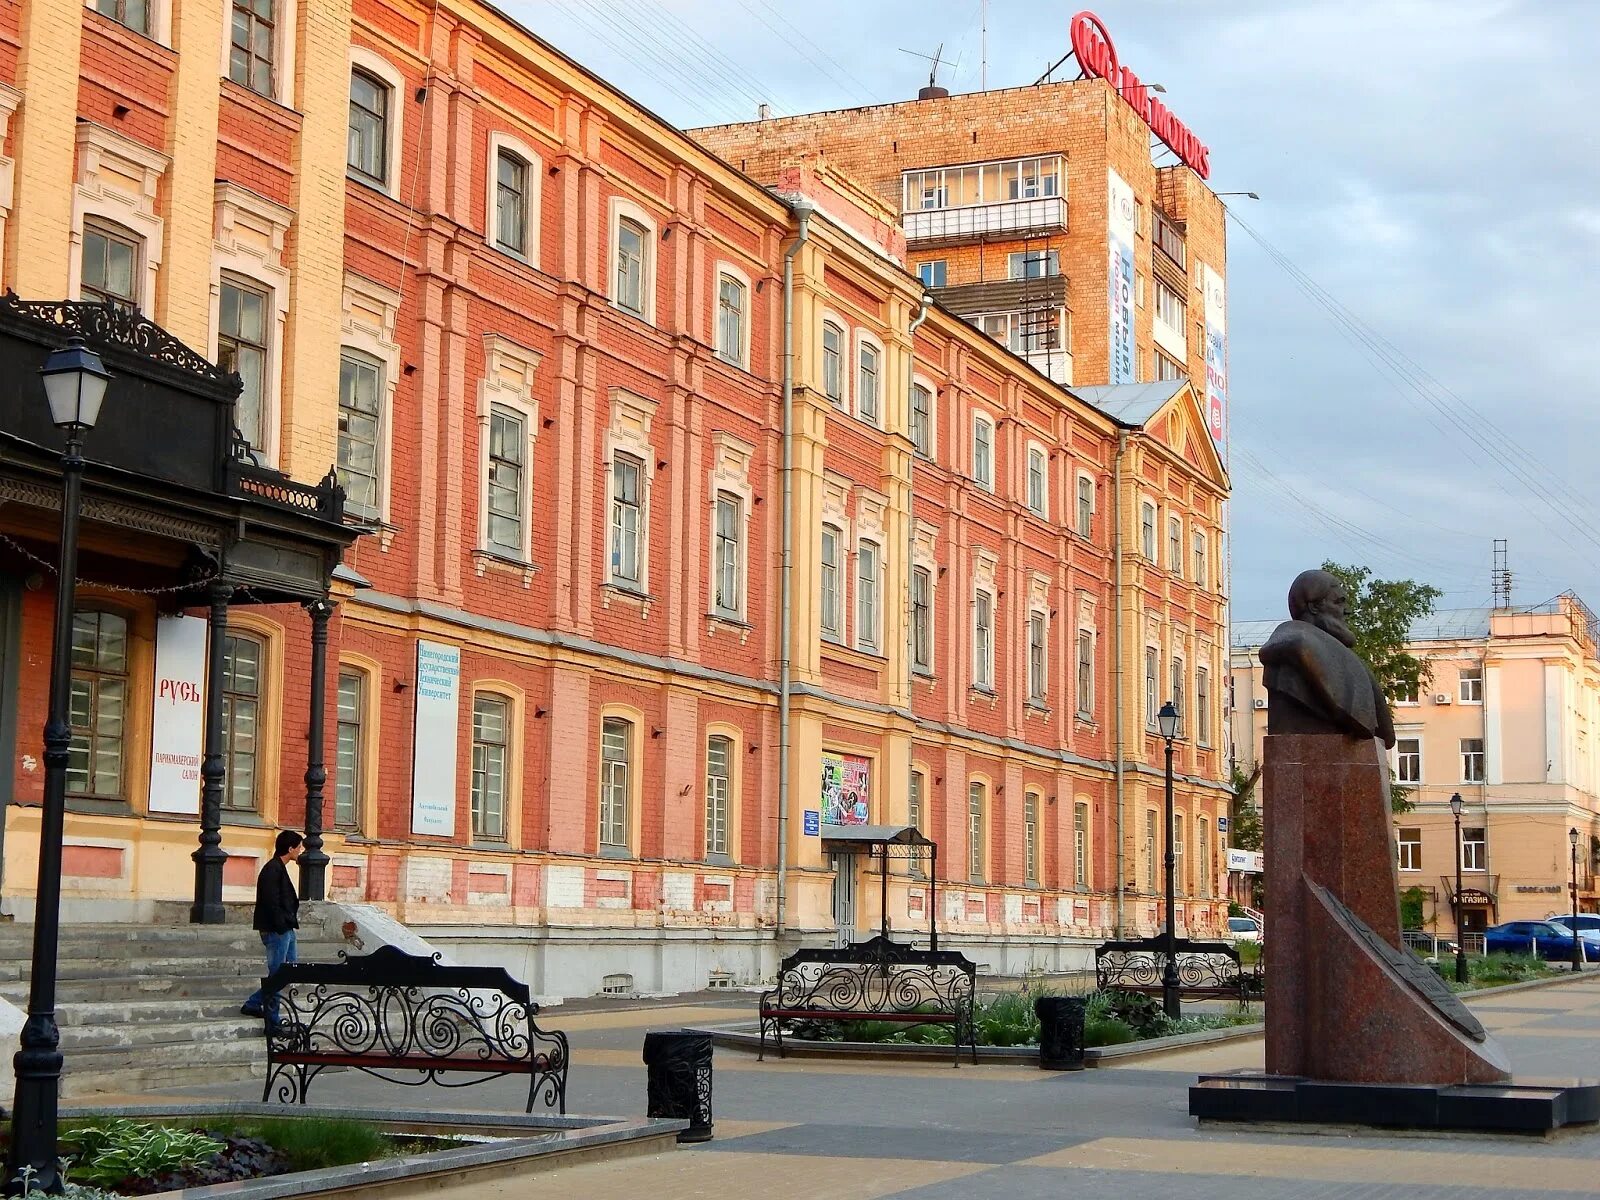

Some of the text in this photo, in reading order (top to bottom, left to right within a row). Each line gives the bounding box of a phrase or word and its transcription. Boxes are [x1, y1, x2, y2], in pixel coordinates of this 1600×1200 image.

[1150, 97, 1211, 180] MOTORS
[1121, 256, 1131, 375] Новый
[1207, 364, 1224, 391] RIO
[419, 644, 459, 663] Нижегородский
[419, 670, 452, 687] Технический
[159, 678, 200, 705] РУСЬ
[418, 682, 452, 700] Университет
[155, 752, 199, 767] ПАРИКМАХЕРСКИЙ
[182, 769, 198, 780] САЛОН
